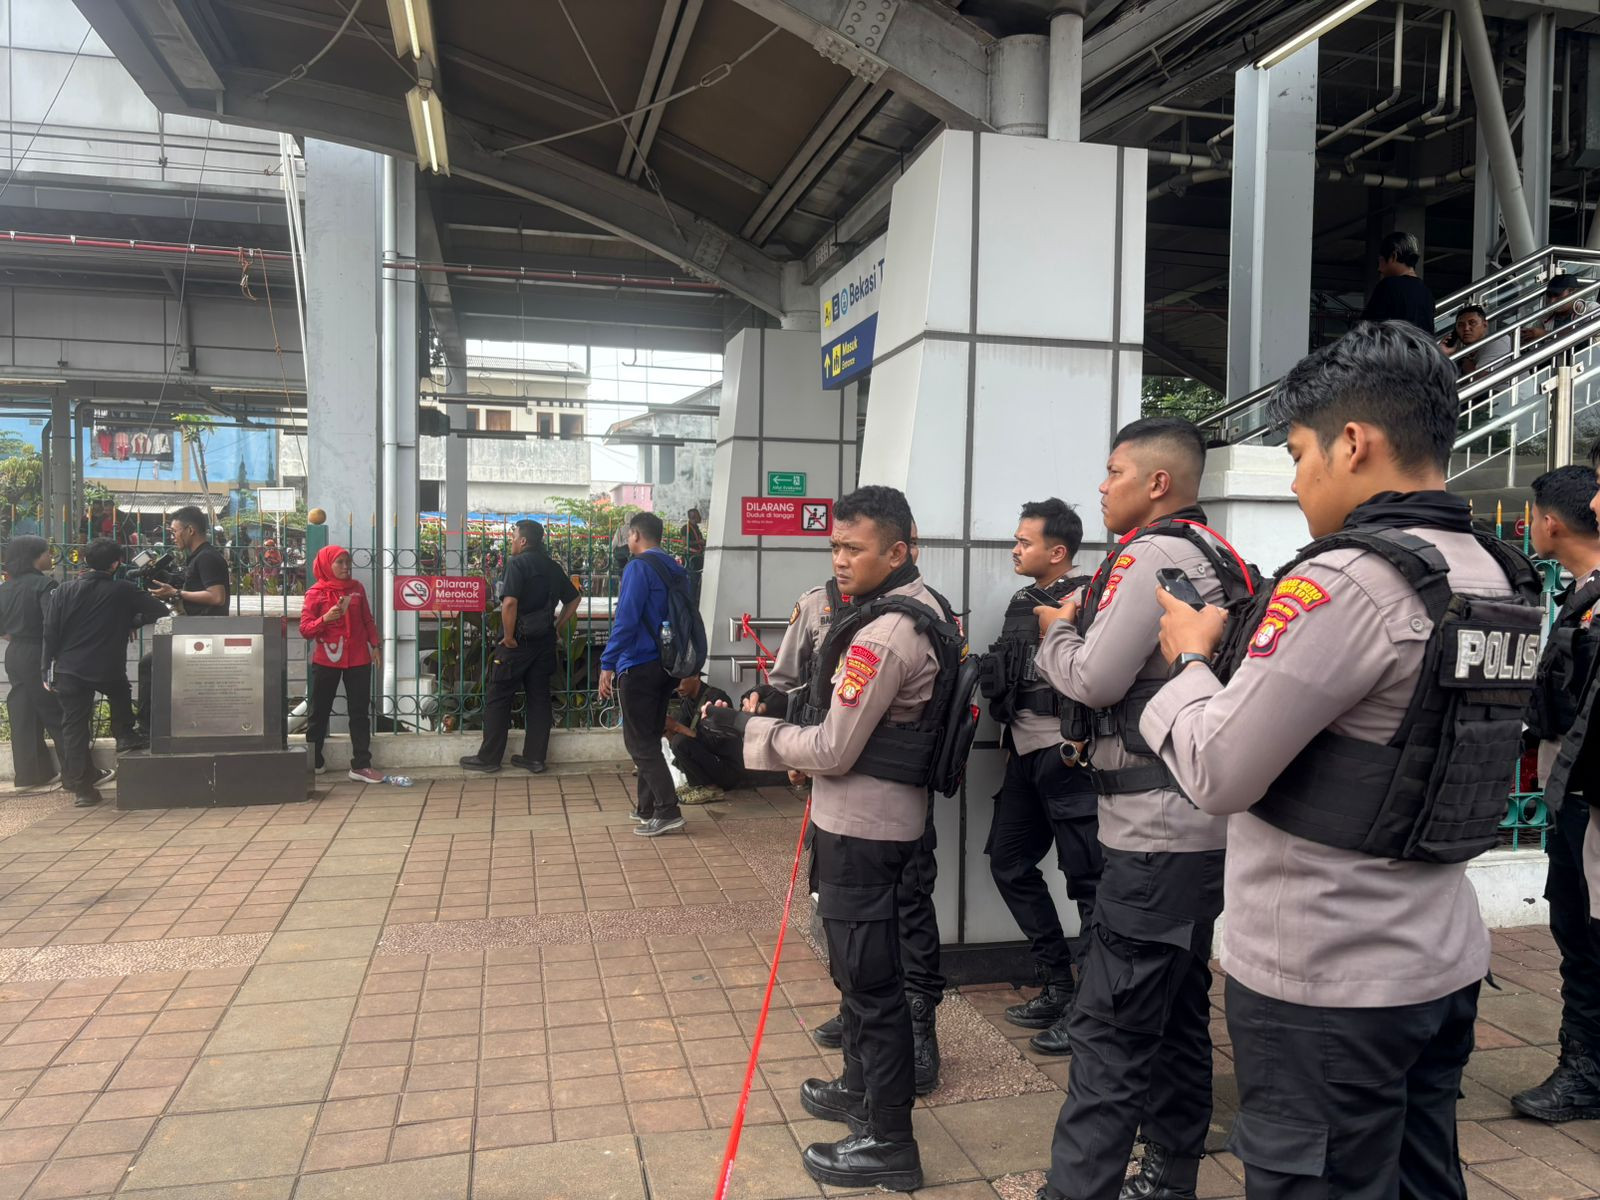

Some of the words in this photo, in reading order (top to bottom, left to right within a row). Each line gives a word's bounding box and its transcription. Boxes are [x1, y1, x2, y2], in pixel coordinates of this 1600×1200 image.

[850, 266, 876, 306] Bekasi
[842, 335, 858, 356] Masuk
[746, 502, 794, 512] DILARANG
[746, 511, 765, 519] Duduk
[773, 512, 794, 520] tangga
[435, 579, 479, 590] Dilarang
[435, 589, 479, 599] Merokok
